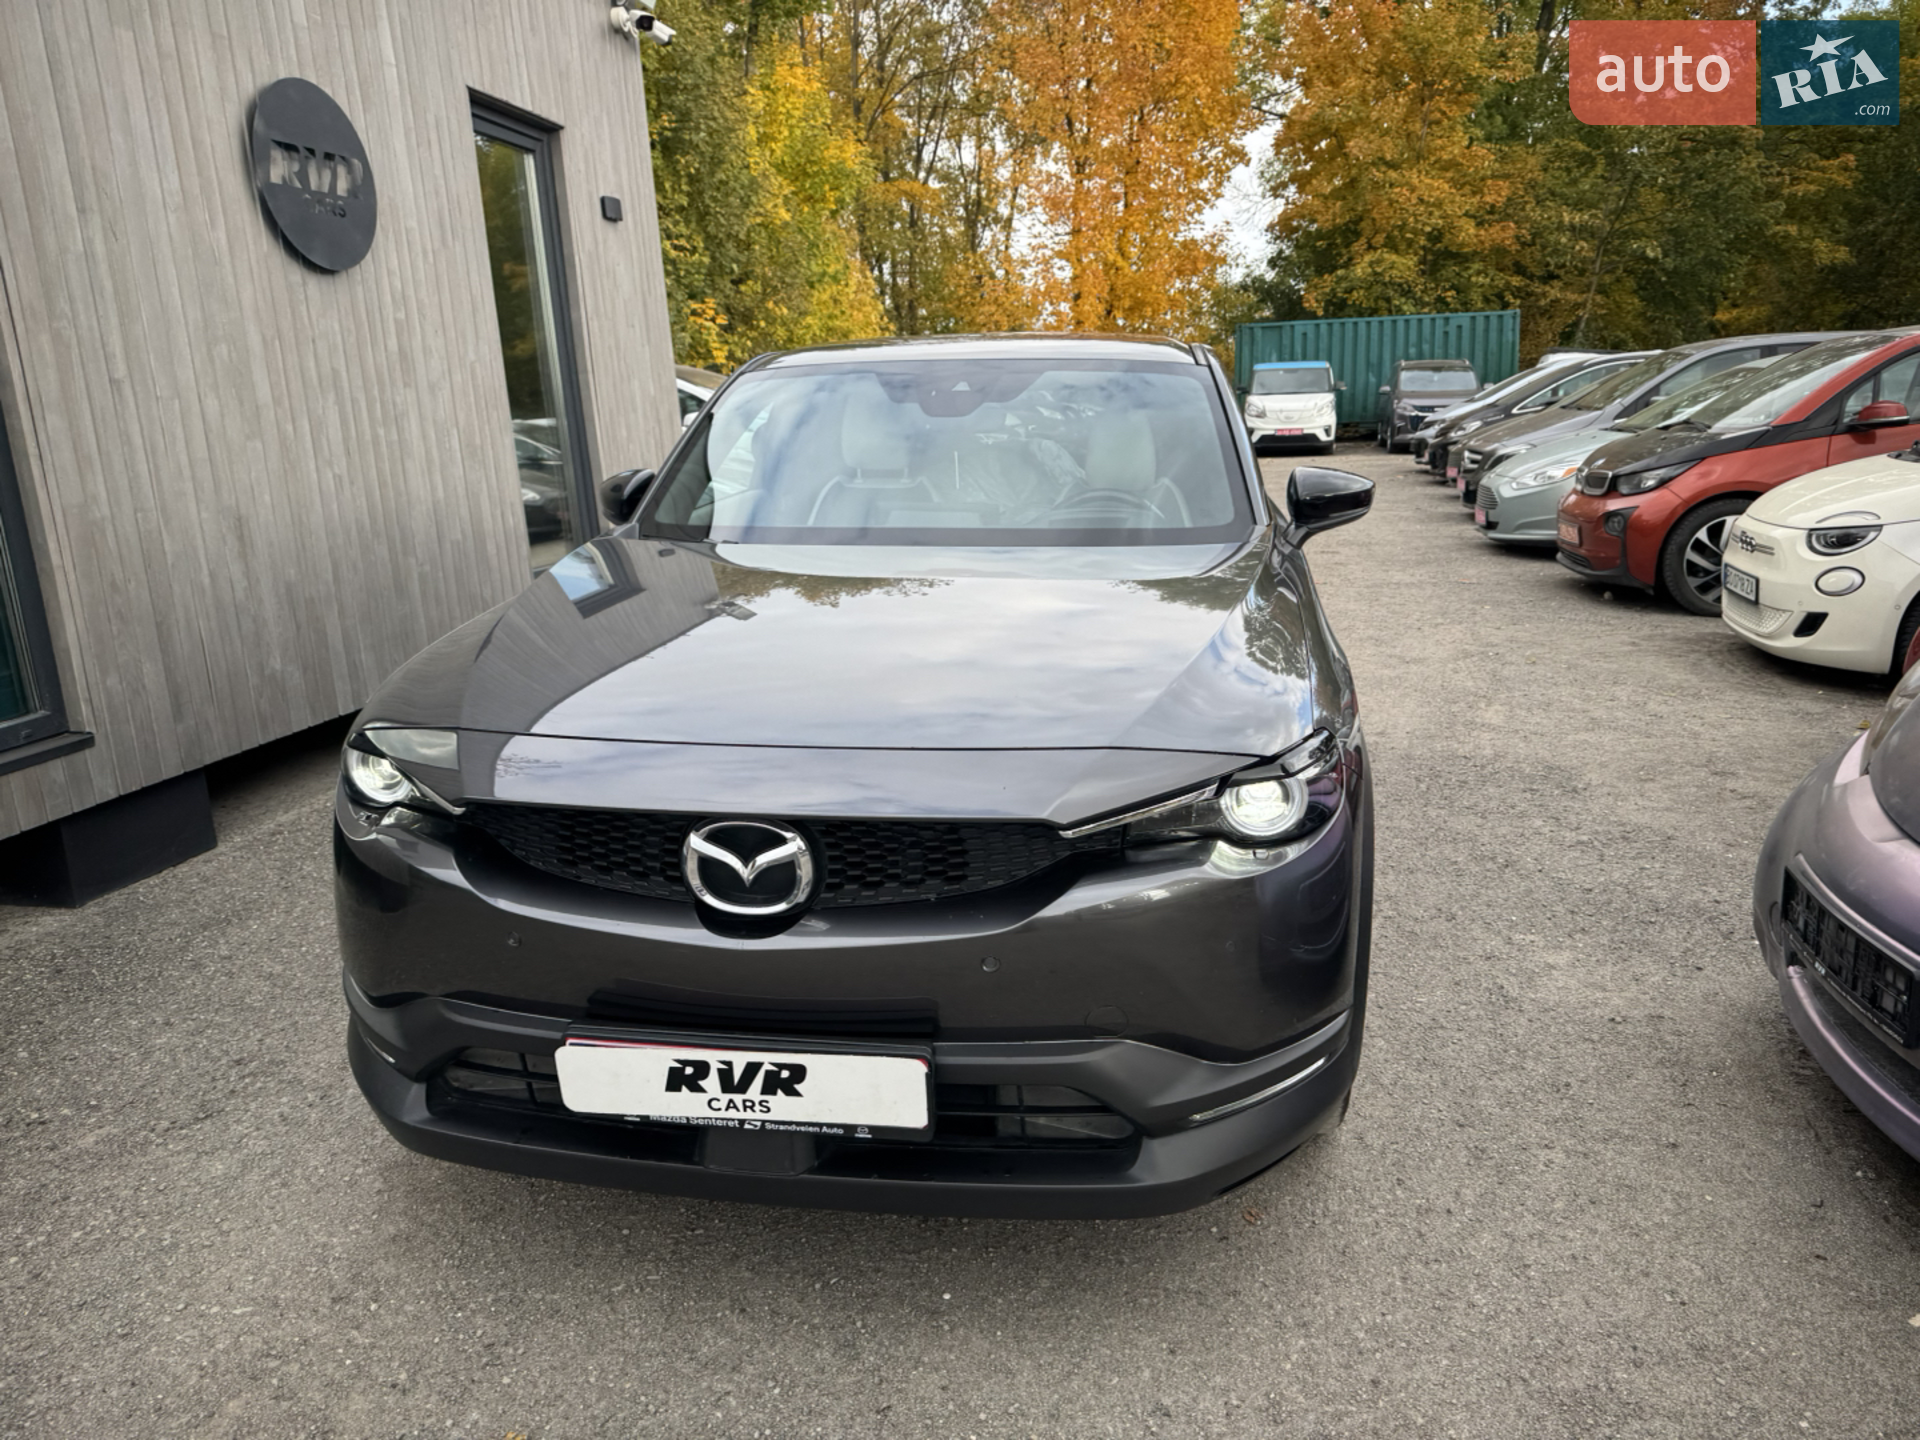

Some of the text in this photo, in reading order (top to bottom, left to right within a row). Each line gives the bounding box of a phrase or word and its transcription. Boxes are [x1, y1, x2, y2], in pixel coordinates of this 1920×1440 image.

[664, 1058, 807, 1098] RVR
[707, 1097, 772, 1114] CARS
[690, 1116, 740, 1128] Senteret
[821, 1125, 844, 1135] Auto
